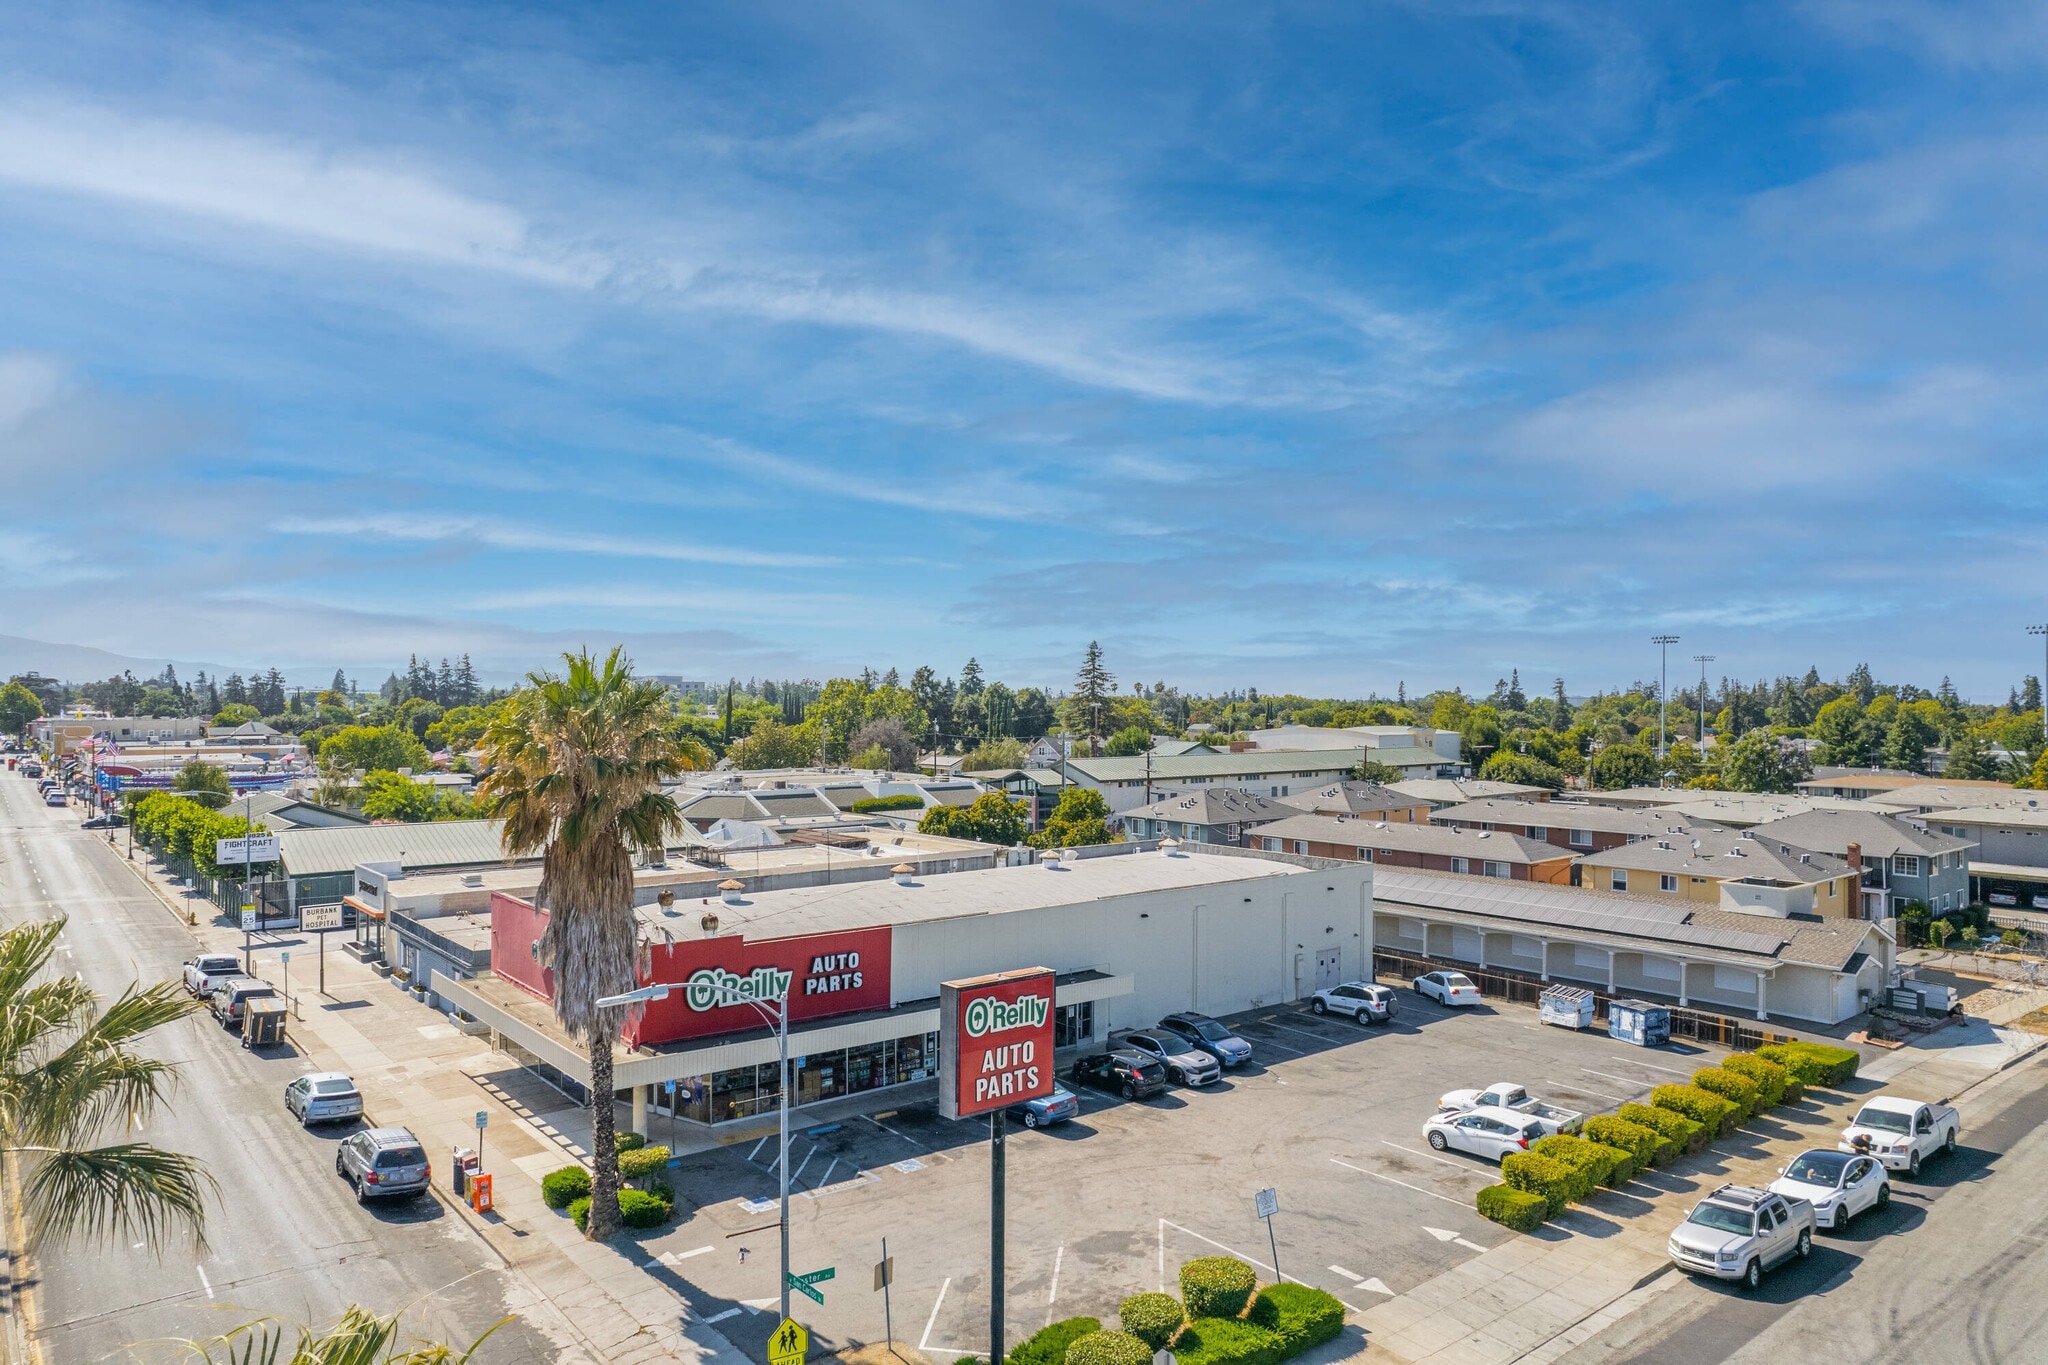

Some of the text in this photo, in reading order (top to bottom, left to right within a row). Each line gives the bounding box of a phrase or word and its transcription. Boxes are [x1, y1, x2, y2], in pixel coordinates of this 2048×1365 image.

[224, 839, 273, 849] FIGHTCRAFT
[306, 907, 338, 916] BURBANK
[305, 920, 338, 929] HOSPITAL
[811, 952, 860, 973] AUTO
[688, 969, 791, 1010] O'Reilly
[805, 972, 863, 996] PARTS
[966, 996, 1048, 1036] O'Reilly
[981, 1040, 1035, 1074] AUTO
[976, 1066, 1039, 1103] PARTS
[793, 1277, 802, 1290] San
[802, 1283, 817, 1300] Carlos
